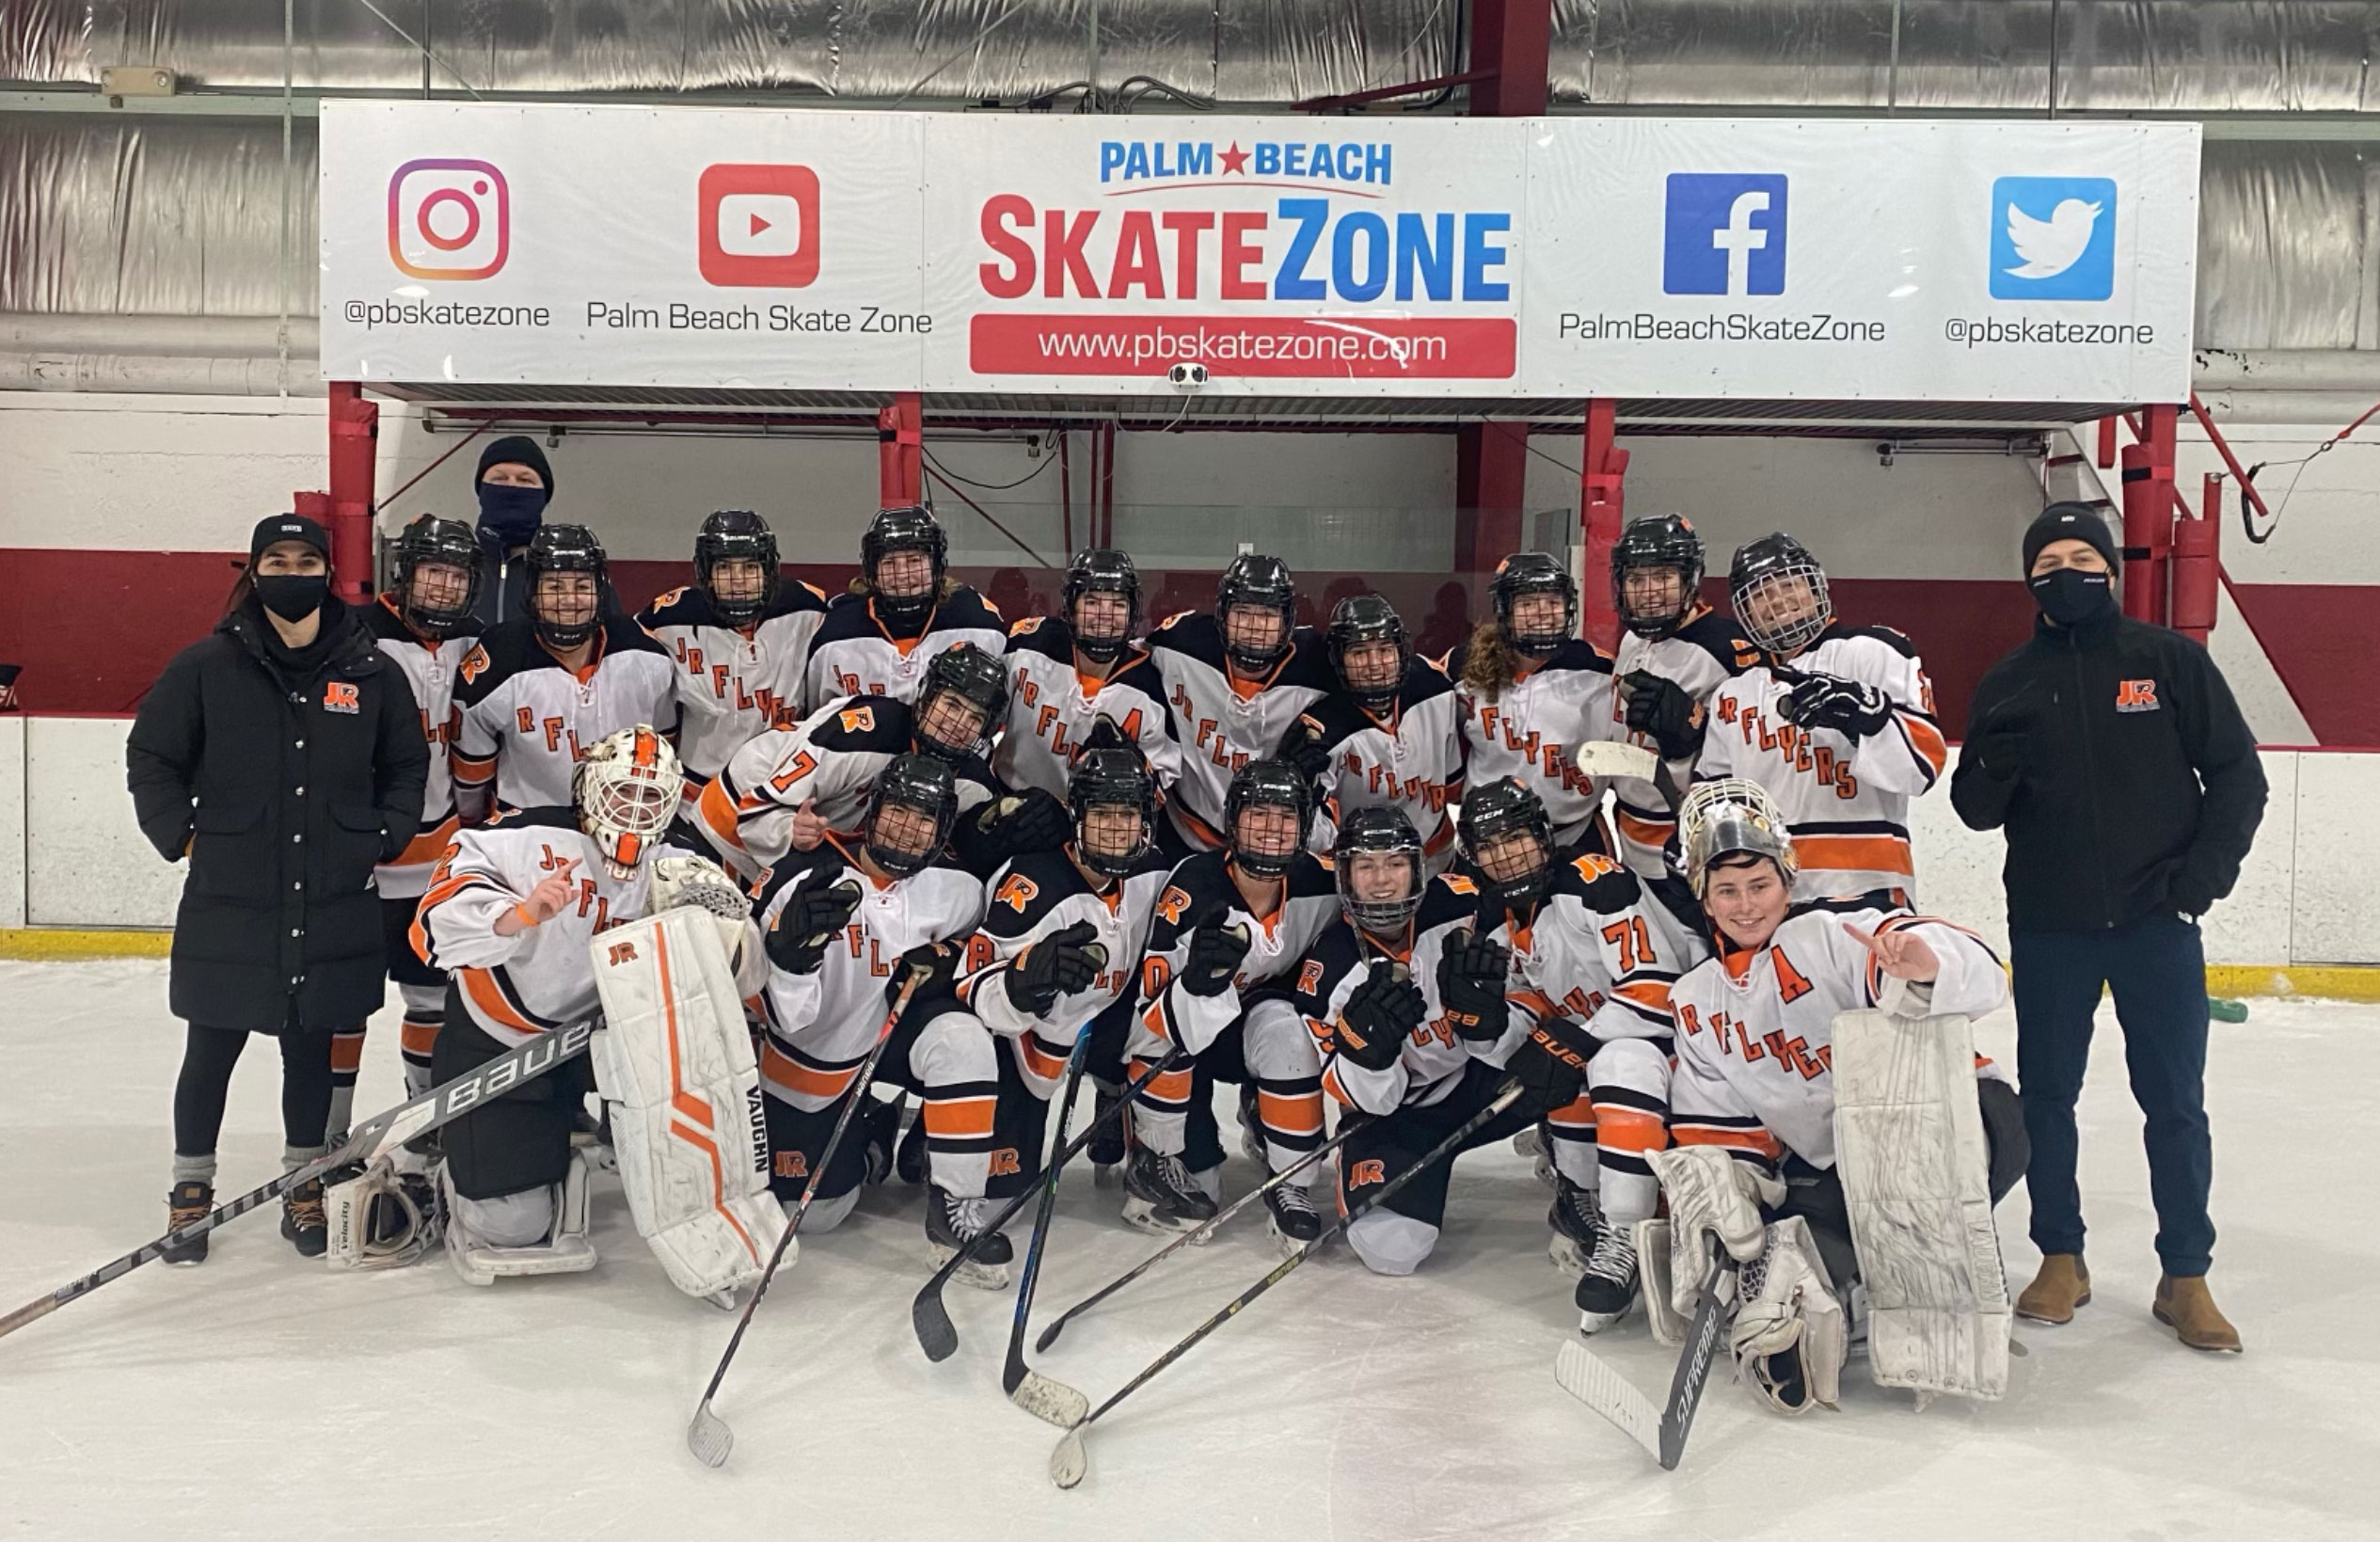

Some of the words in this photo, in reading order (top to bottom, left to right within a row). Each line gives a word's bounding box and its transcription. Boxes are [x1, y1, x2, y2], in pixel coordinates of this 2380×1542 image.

[1101, 141, 1214, 183] PALM
[1254, 142, 1392, 186] BEACH
[344, 298, 550, 330] @pbskatezone
[587, 302, 659, 329] Palm
[669, 303, 759, 331] Beach
[769, 304, 851, 333] Skate
[860, 306, 933, 334] Zone
[1559, 312, 1886, 342] PalmBeachSkateZone
[1038, 326, 1447, 365] www.pbskatezone.com
[1944, 316, 2154, 350] @pbskatezone
[1740, 706, 1859, 801] FLYERS
[1474, 808, 1505, 823] CCM
[609, 941, 639, 967] JR
[1601, 914, 1658, 974] 71
[1771, 944, 1814, 1005] A
[1708, 1009, 1833, 1082] FLYE
[745, 1082, 769, 1174] VAUGHN
[774, 1150, 809, 1179] JR
[1349, 1158, 1386, 1192] JR
[1677, 1305, 1720, 1439] SUPREME
